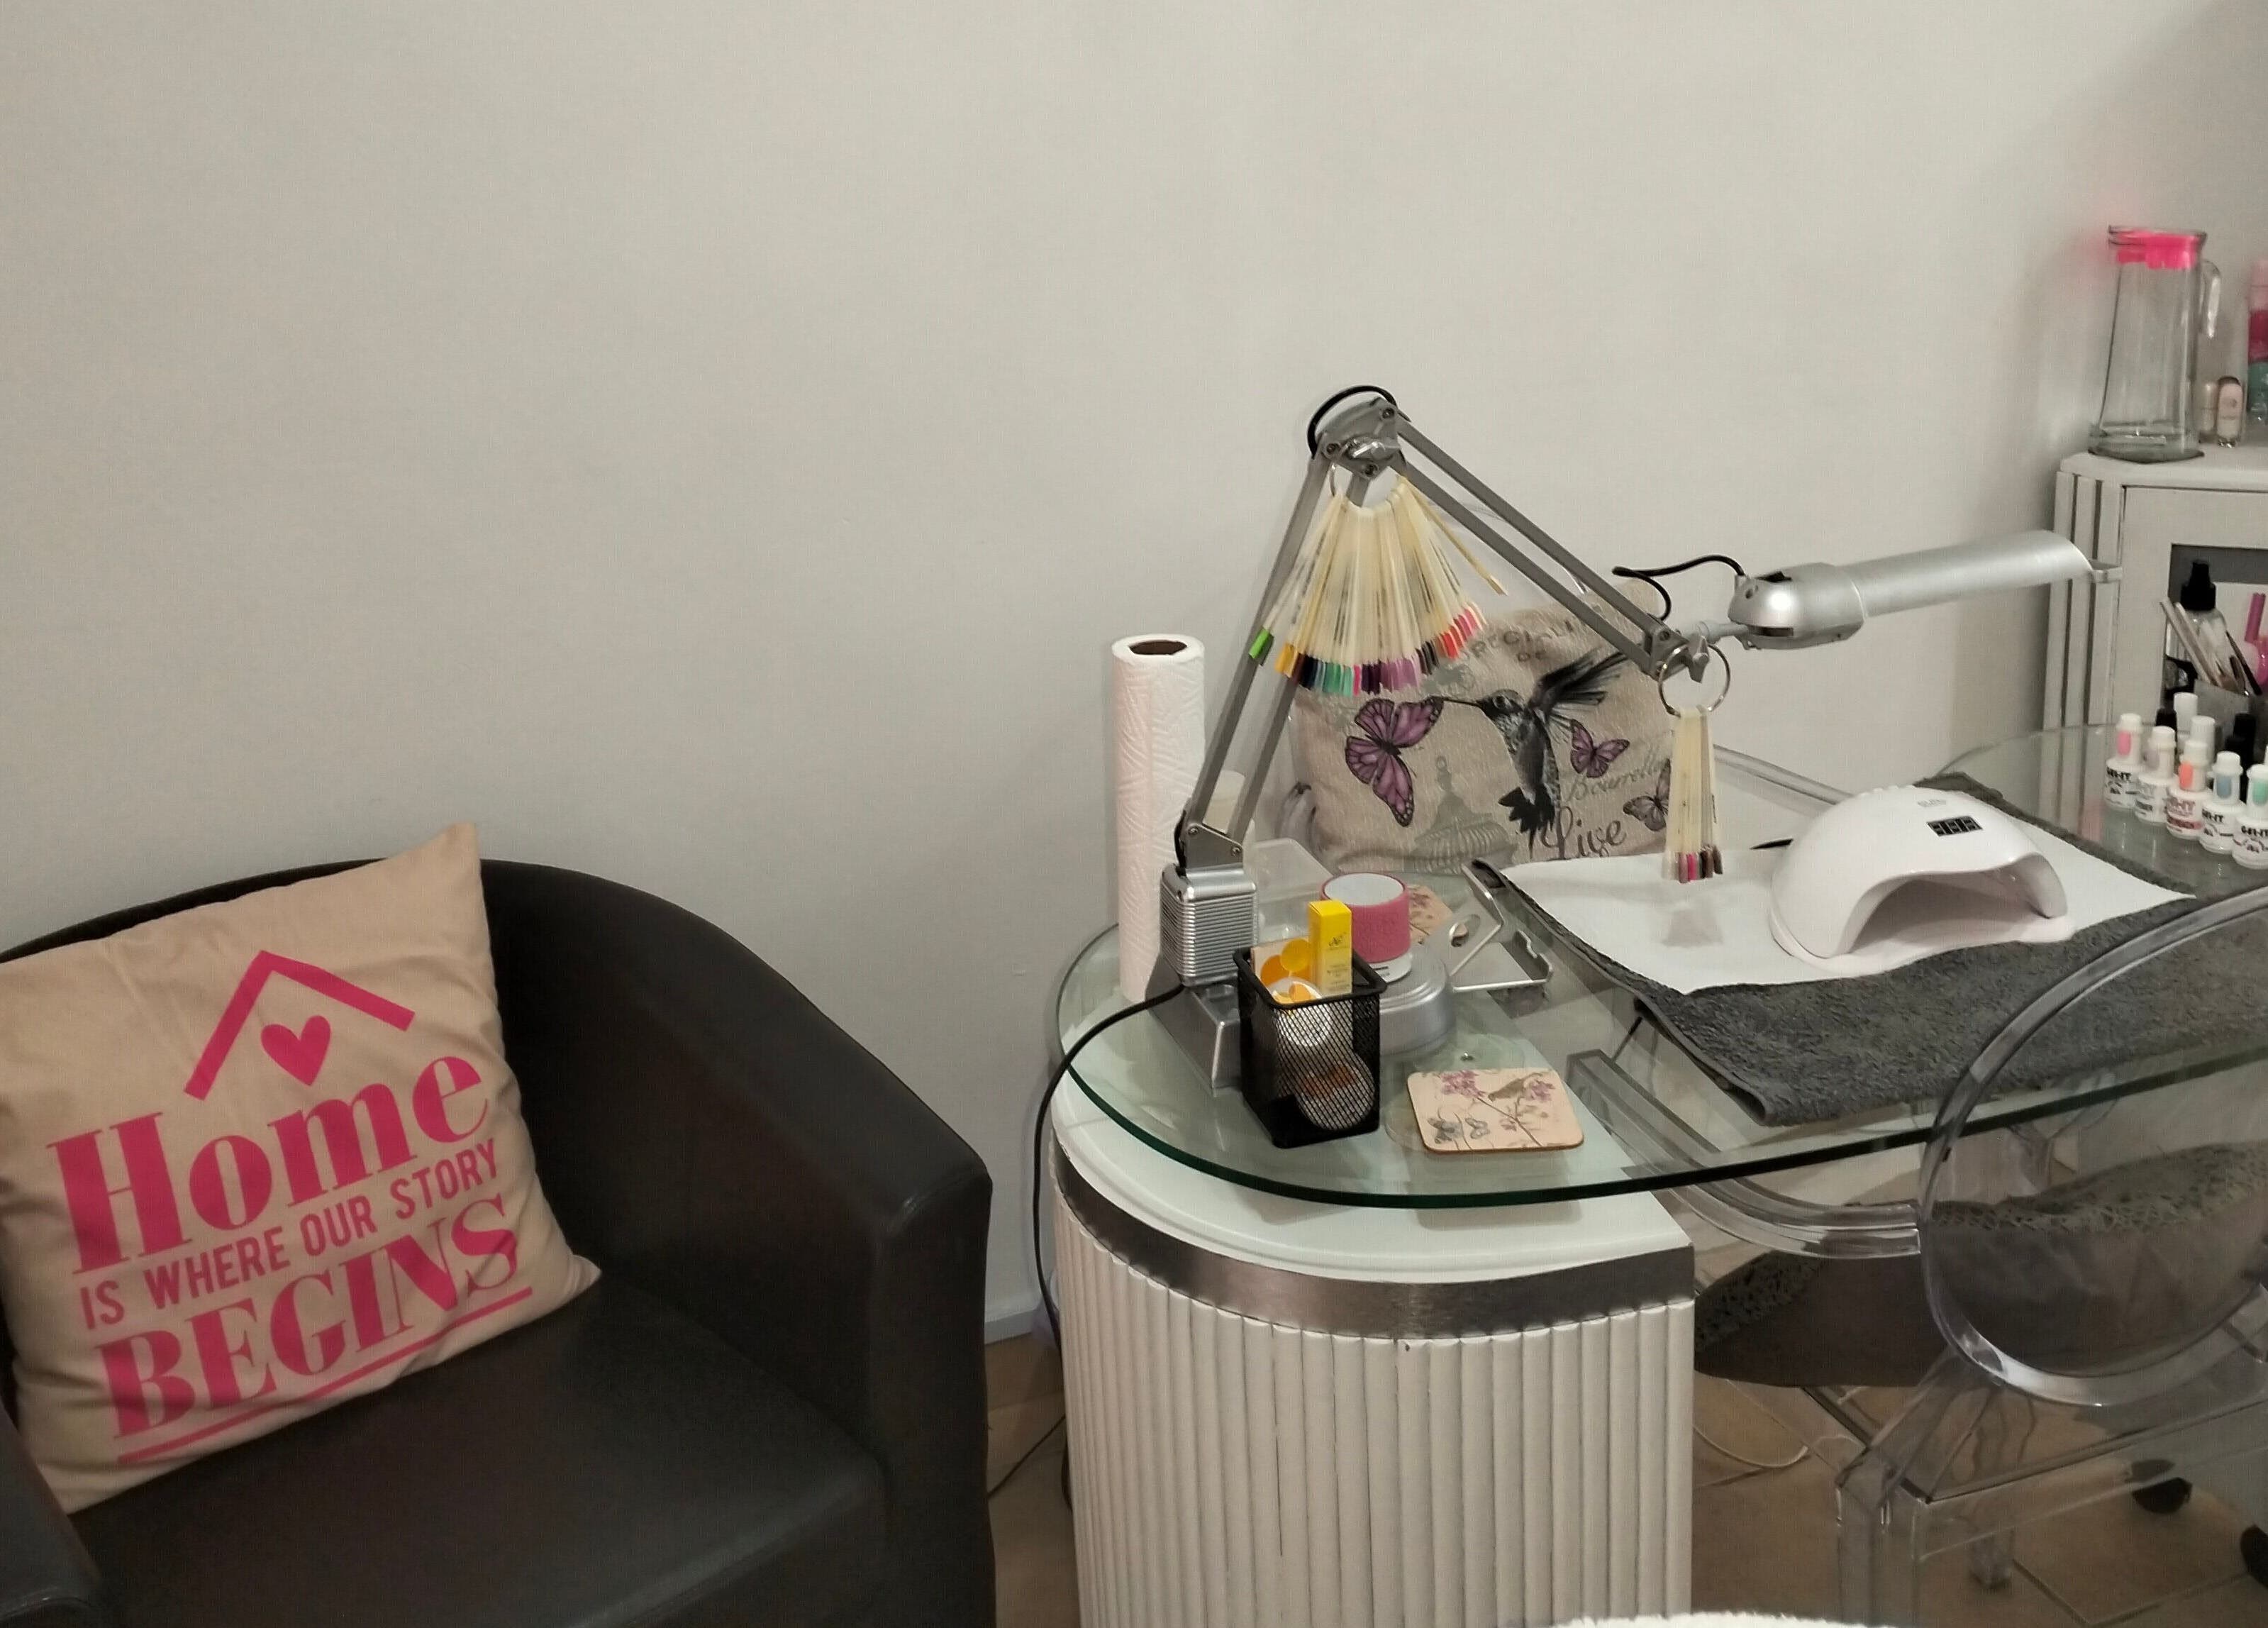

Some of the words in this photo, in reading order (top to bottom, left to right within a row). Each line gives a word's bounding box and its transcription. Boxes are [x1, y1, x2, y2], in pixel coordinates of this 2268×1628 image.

[46, 1056, 489, 1274] Home
[80, 1280, 124, 1329] IS
[144, 1226, 289, 1309] WHERE
[300, 1195, 377, 1256] OUR
[391, 1138, 498, 1219] STORY
[95, 1193, 518, 1439] BEGINS
